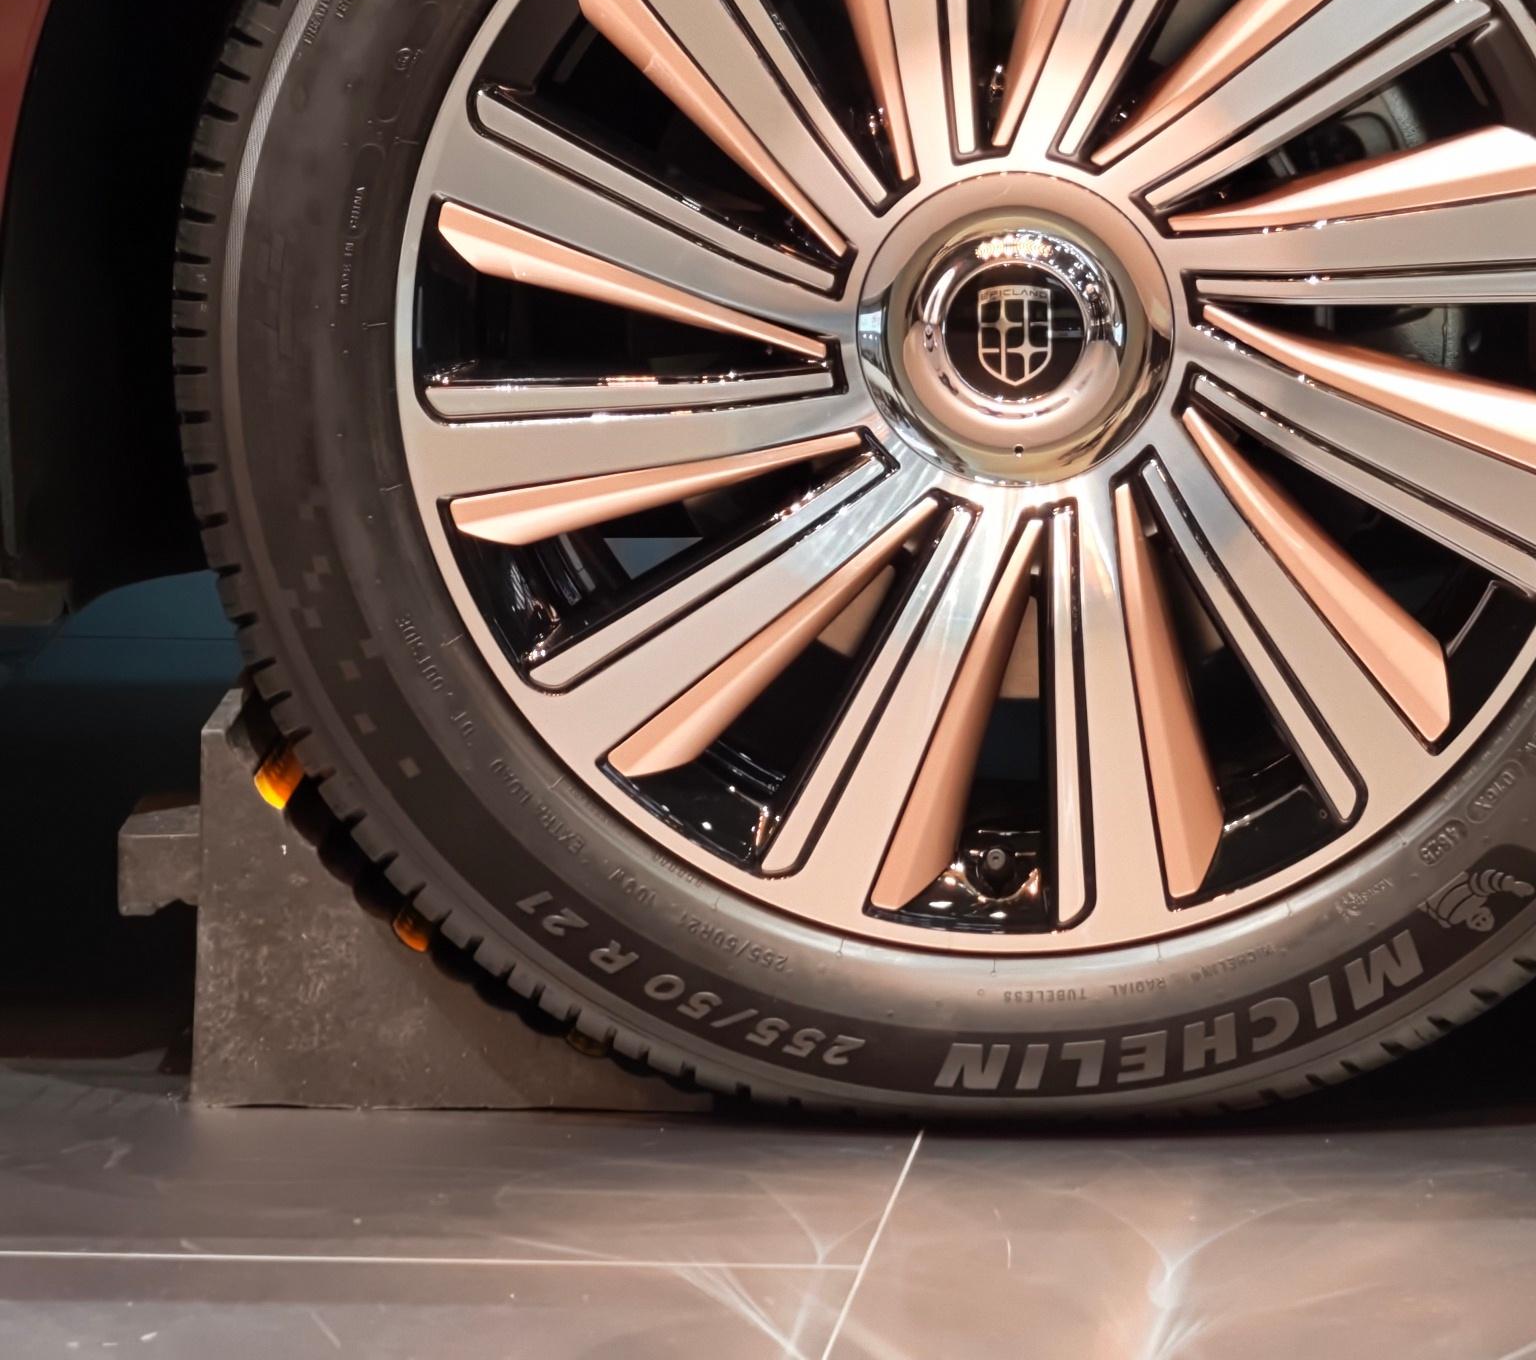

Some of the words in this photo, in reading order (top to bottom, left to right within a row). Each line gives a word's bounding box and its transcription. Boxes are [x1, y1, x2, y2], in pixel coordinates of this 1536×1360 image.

[344, 181, 368, 230] CHINA
[981, 288, 1048, 301] EPICLAND
[516, 890, 590, 937] 21
[589, 939, 639, 974] R
[1001, 985, 1087, 1005] TUBELESS
[1107, 973, 1167, 999] RADIAL
[643, 972, 866, 1066] 255/50
[934, 929, 1424, 1091] MICHELIN
